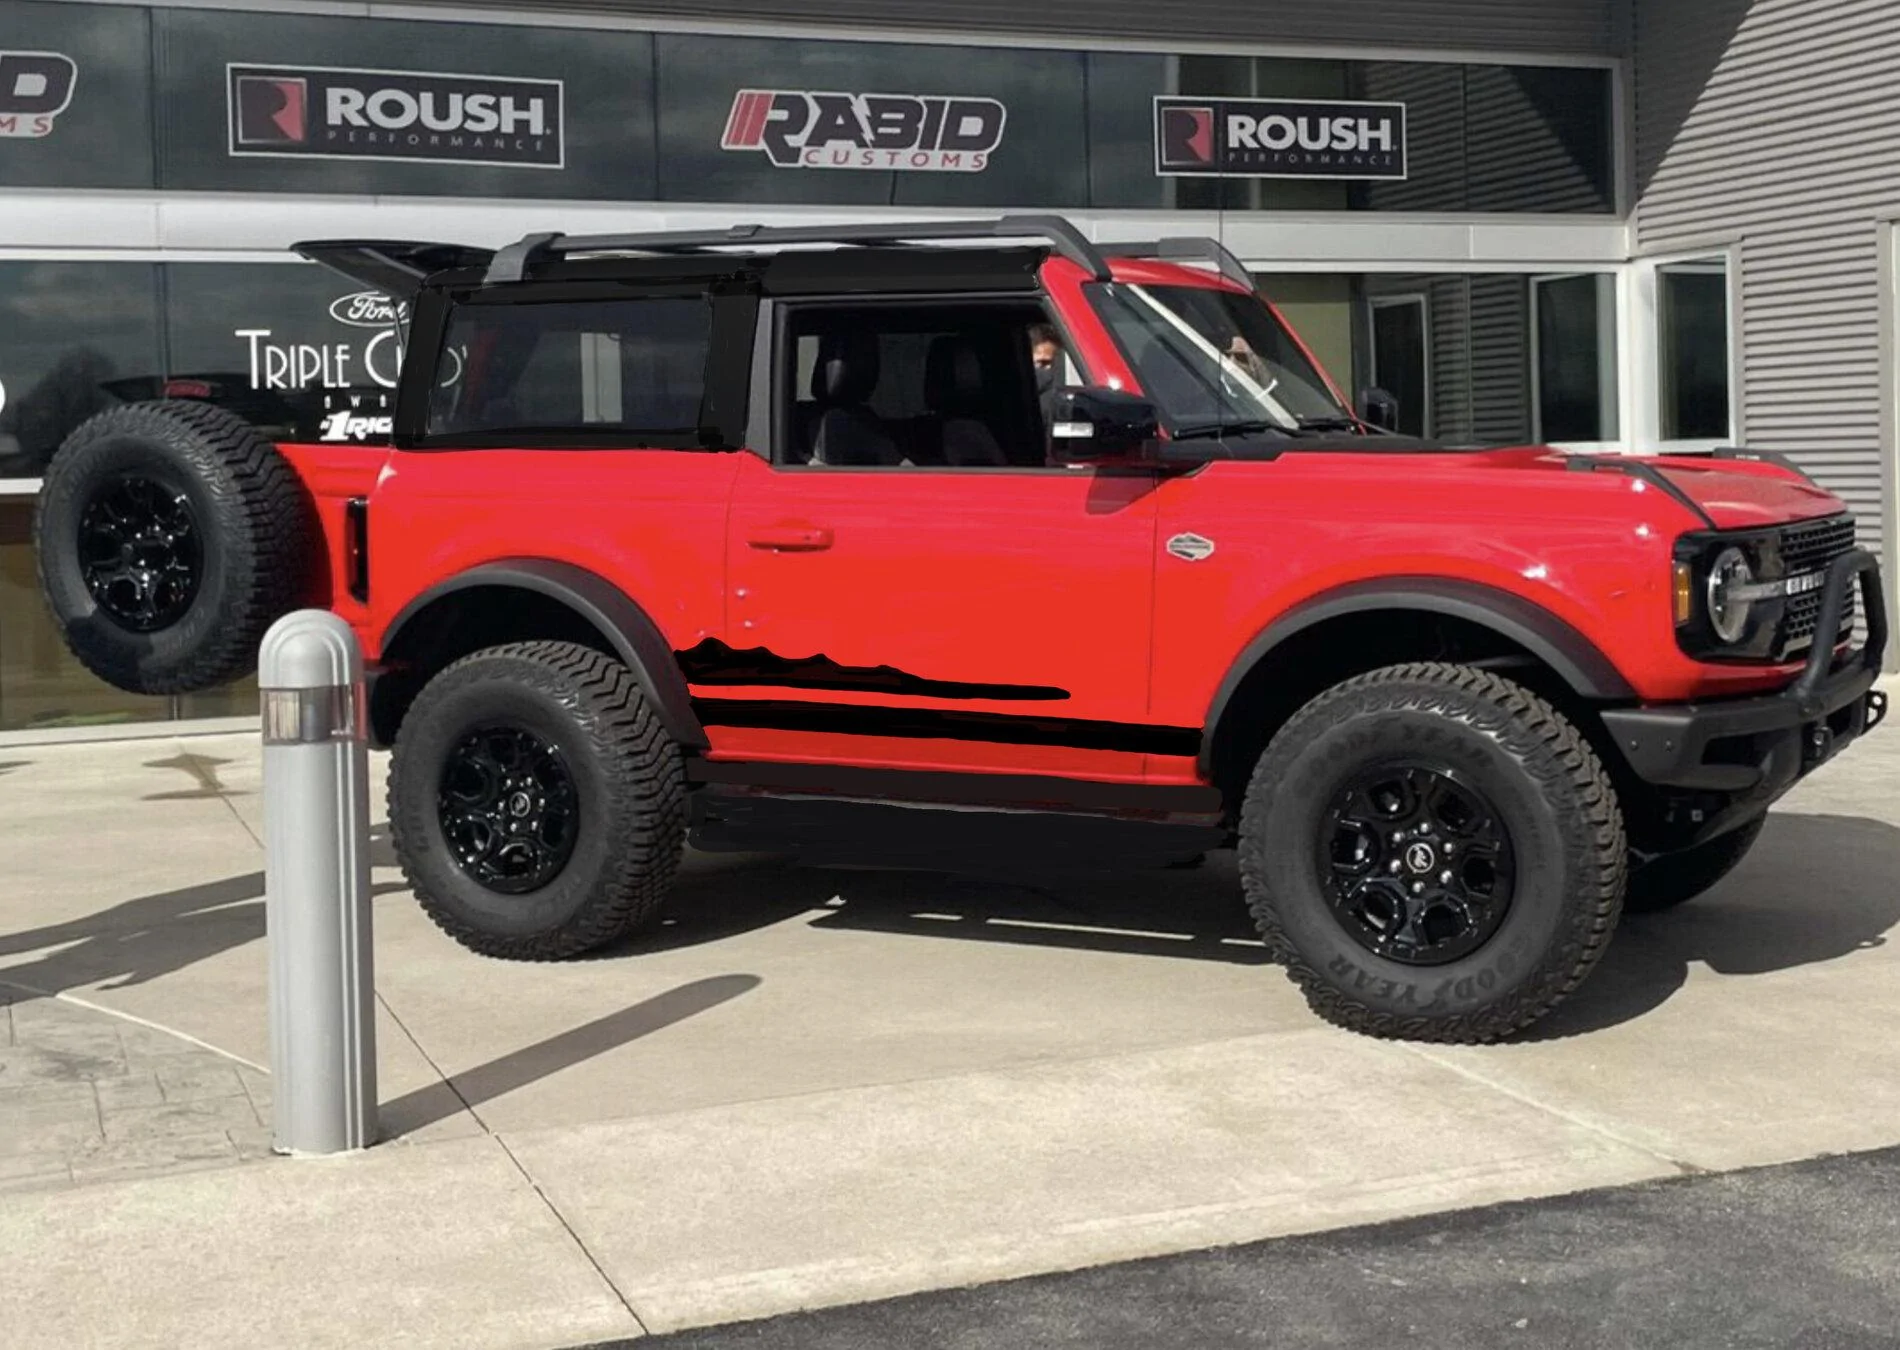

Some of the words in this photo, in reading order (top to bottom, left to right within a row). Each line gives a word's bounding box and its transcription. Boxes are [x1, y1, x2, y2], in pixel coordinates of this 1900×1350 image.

[326, 88, 544, 135] ROUSH
[327, 131, 543, 151] PERFORMANCE
[758, 91, 1005, 164] RABID
[1228, 115, 1391, 151] ROUSH
[804, 150, 986, 167] CUSTOMS
[1229, 153, 1392, 165] PERFORMANCE
